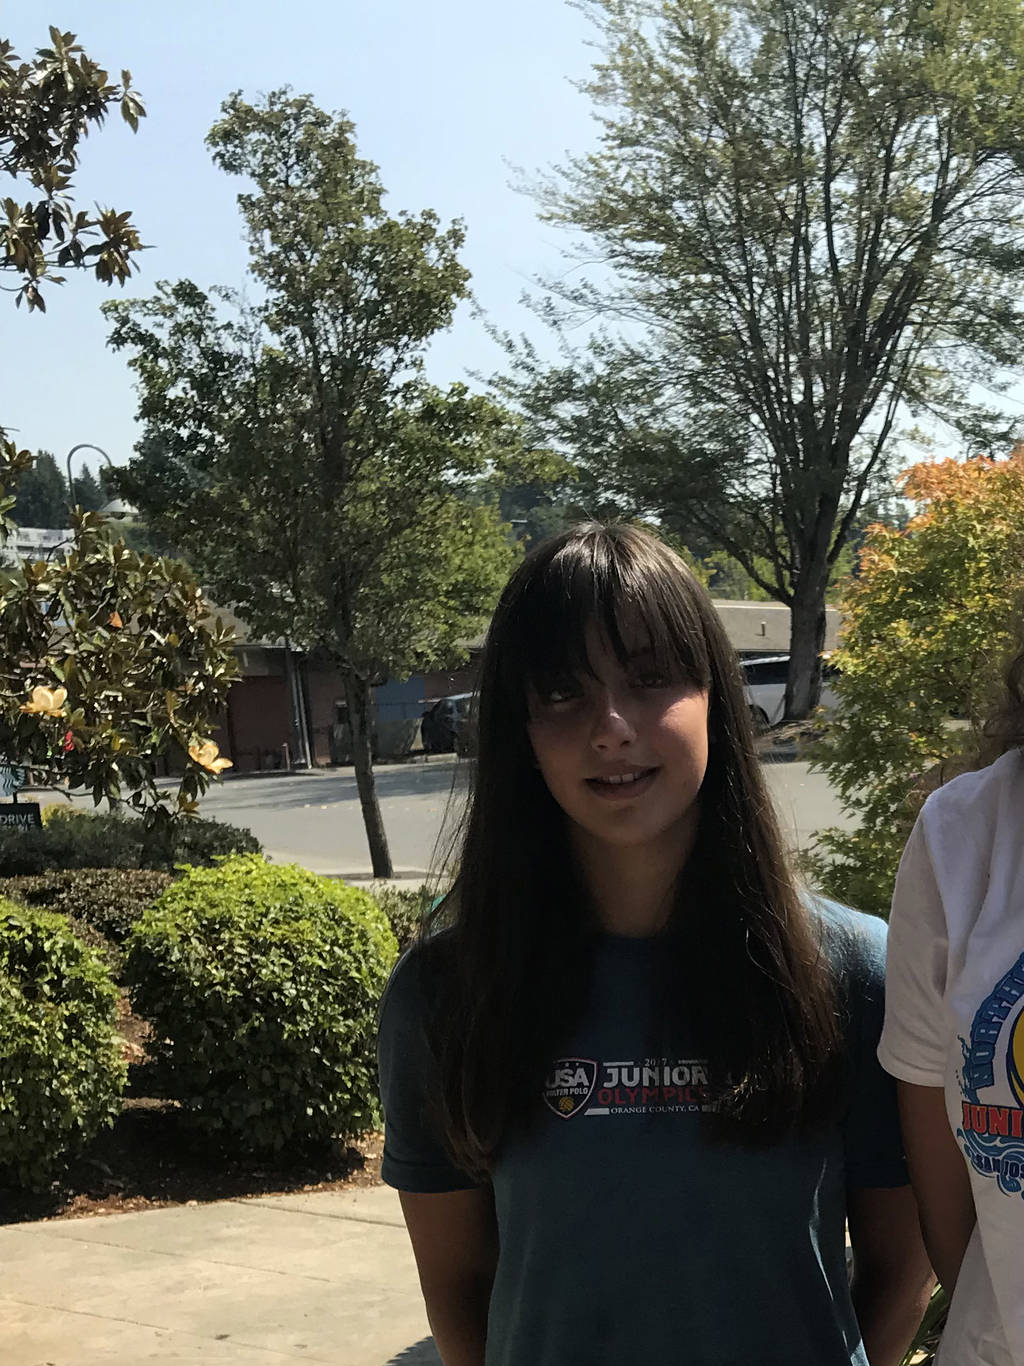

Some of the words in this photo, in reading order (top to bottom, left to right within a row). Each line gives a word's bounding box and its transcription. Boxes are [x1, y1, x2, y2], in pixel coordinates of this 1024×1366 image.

[0, 813, 35, 824] DRIVE
[545, 1067, 590, 1089] USA
[603, 1066, 708, 1088] JUNIOR
[570, 1087, 588, 1095] POLO
[611, 1105, 646, 1114] ORANGE
[688, 1104, 700, 1112] CA
[976, 1154, 1001, 1173] SAN
